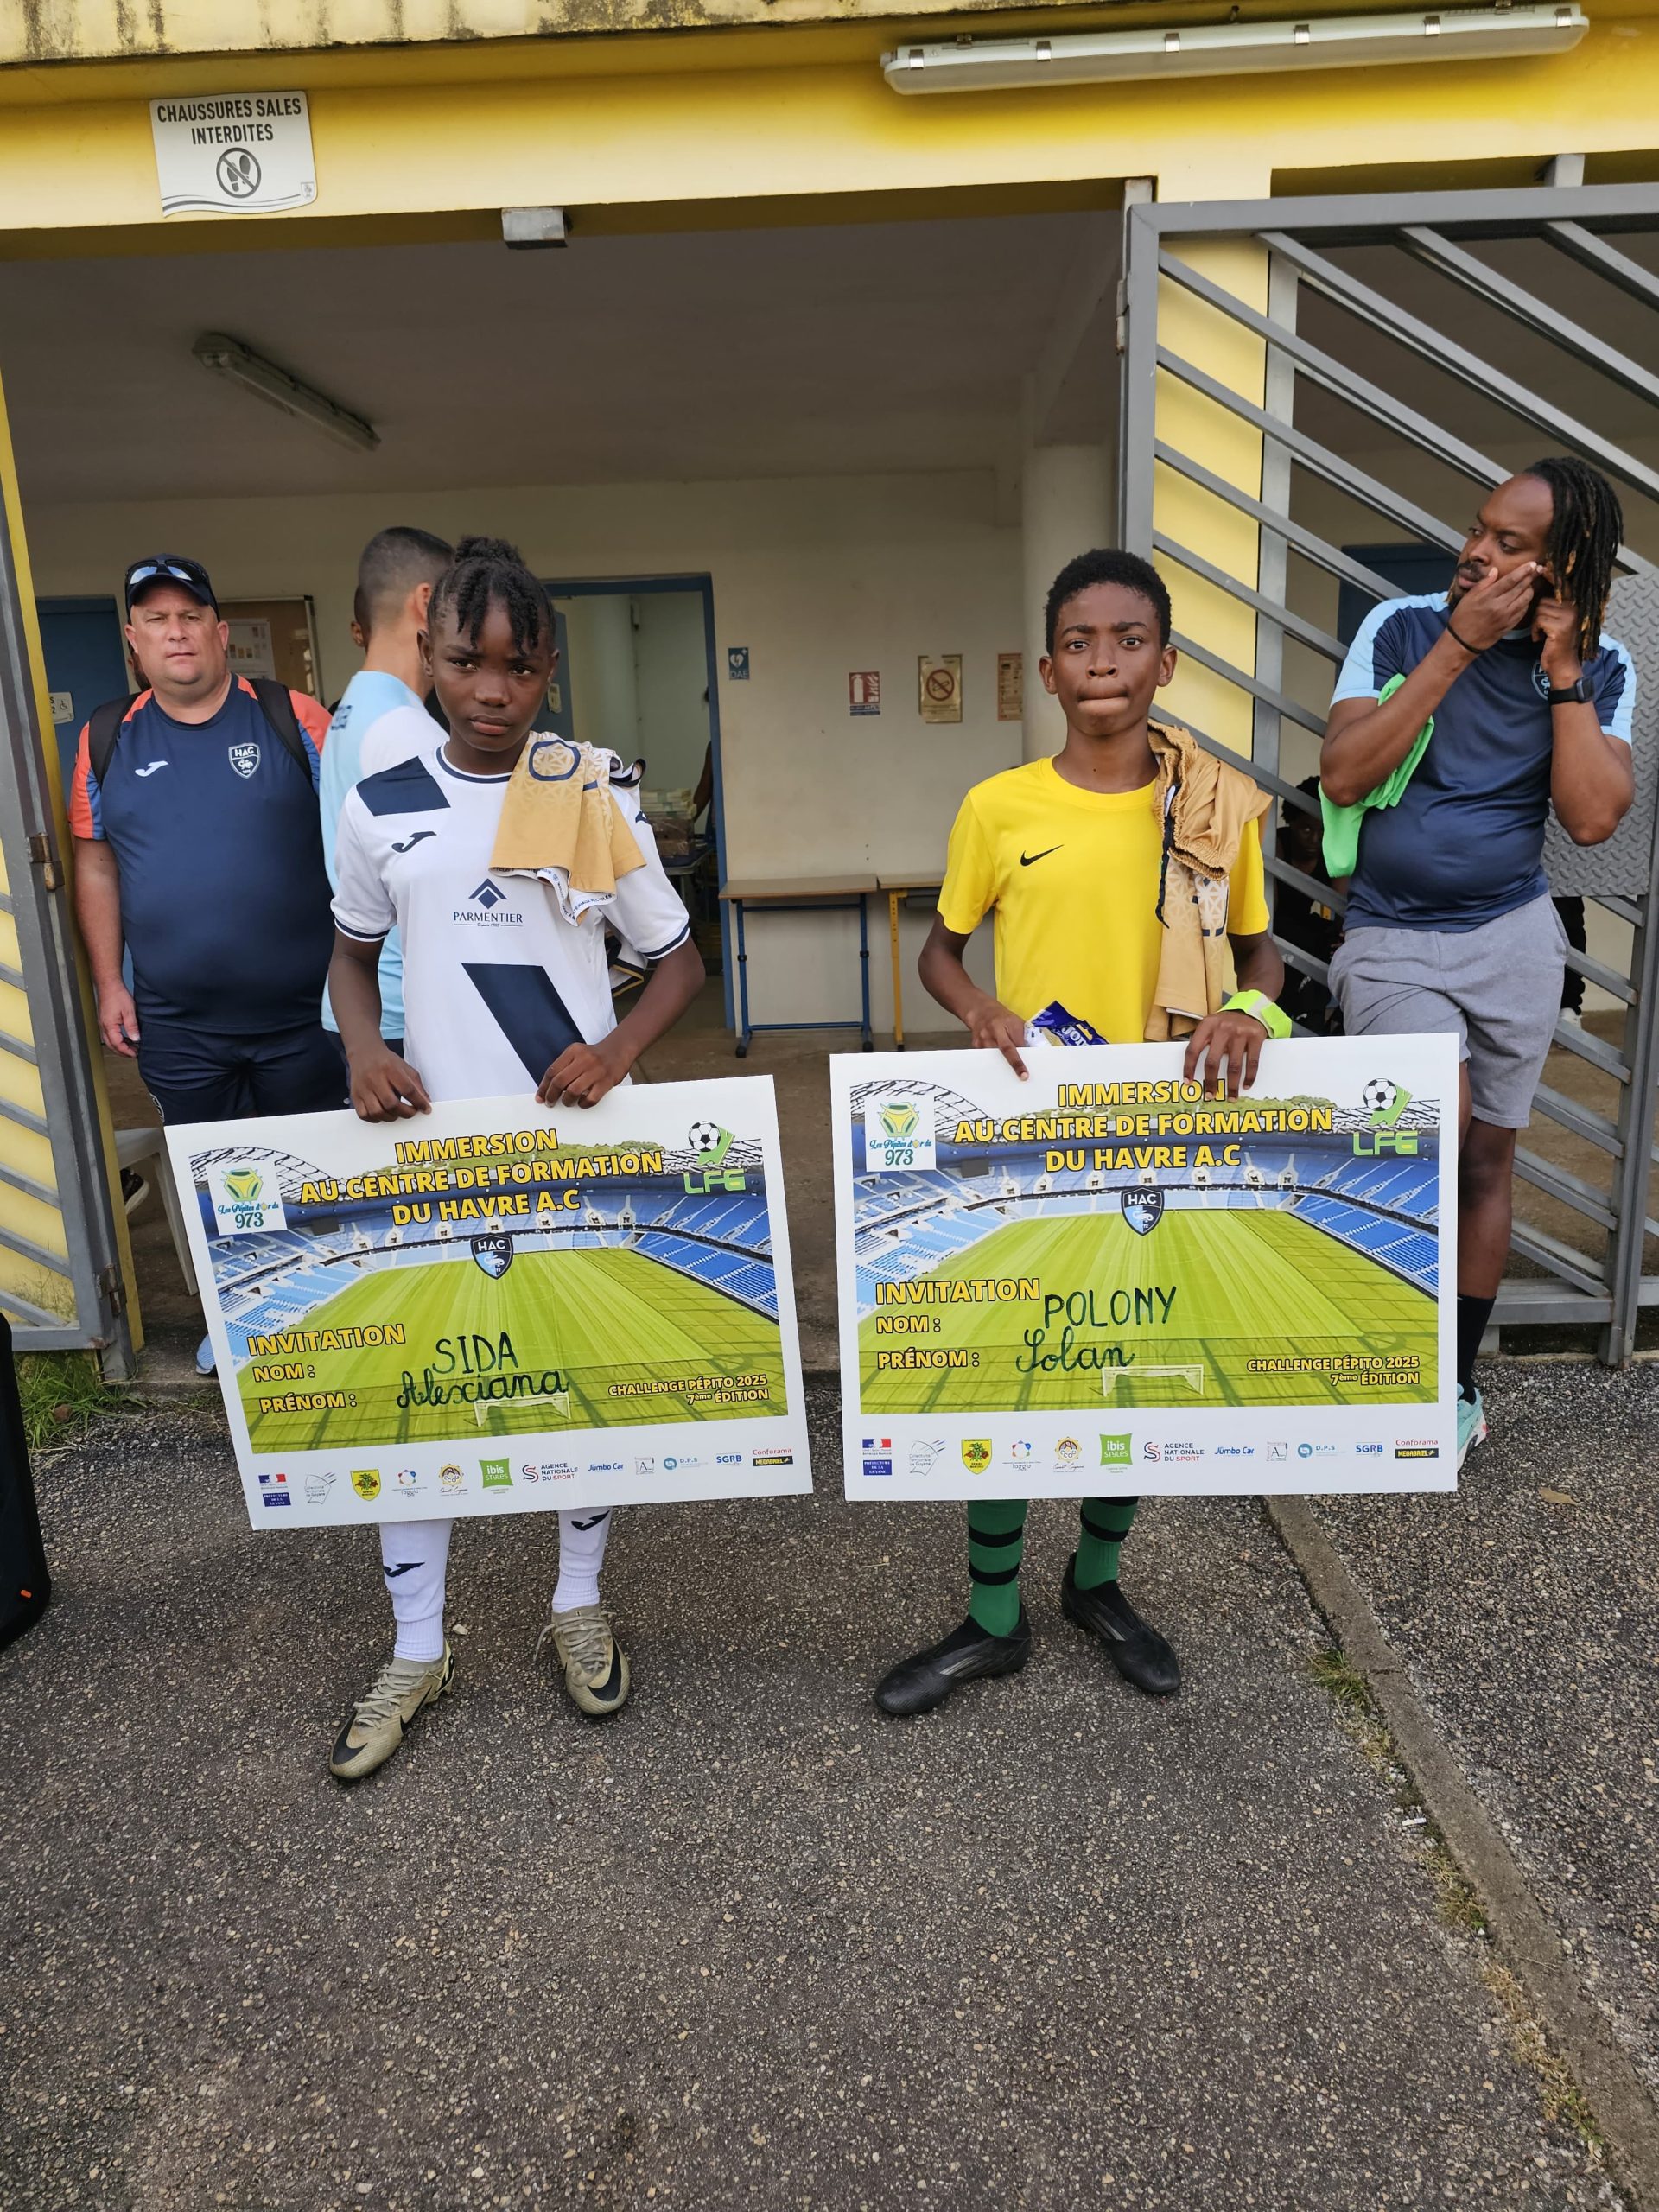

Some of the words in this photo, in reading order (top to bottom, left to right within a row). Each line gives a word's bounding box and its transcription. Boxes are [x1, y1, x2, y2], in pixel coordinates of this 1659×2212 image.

[156, 99, 253, 123] CHAUSSURES
[257, 98, 302, 118] SALES
[191, 124, 274, 145] INTERDITES
[729, 670, 749, 679] DAE
[234, 746, 255, 757] HAC
[454, 912, 523, 923] PARMENTIER
[953, 1120, 995, 1143] AU
[1001, 1116, 1109, 1141] CENTRE
[1115, 1114, 1151, 1137] DE
[1157, 1108, 1333, 1136] FORMATION
[394, 1128, 558, 1164] IMMERSION
[1352, 1129, 1419, 1156] LFG
[885, 1148, 914, 1166] 973
[1046, 1149, 1086, 1173] DU
[1093, 1145, 1188, 1170] HAVRE
[1193, 1143, 1242, 1167] A.C
[299, 1180, 340, 1205] AU
[345, 1169, 450, 1200] CENTRE
[454, 1166, 491, 1191] DE
[497, 1151, 663, 1186] FORMATION
[683, 1168, 747, 1195] LFG
[391, 1202, 433, 1226] DU
[438, 1195, 531, 1223] HAVRE
[537, 1189, 582, 1213] A.C
[1128, 1193, 1157, 1205] HAC
[235, 1212, 264, 1229] 973
[477, 1239, 506, 1252] HAC
[875, 1277, 1040, 1306] INVITATION
[1044, 1286, 1177, 1329] POLONY
[247, 1323, 406, 1357] INVITATION
[432, 1332, 518, 1375] SIDA
[1247, 1357, 1331, 1372] CHALLENGE
[1333, 1355, 1383, 1370] PÉPITO
[1385, 1356, 1420, 1369] 2025
[608, 1380, 686, 1397] CHALLENGE
[688, 1376, 734, 1391] PÉPITO
[736, 1374, 768, 1388] 2025
[1331, 1373, 1358, 1386] 7ème
[1360, 1370, 1420, 1386] ÉDITION
[685, 1392, 712, 1405] 7ème
[714, 1389, 770, 1404] ÉDITION
[752, 1447, 792, 1456] Conforama
[1107, 1440, 1125, 1451] ibis
[1242, 1446, 1255, 1455] Car
[1356, 1444, 1383, 1453] SGRB
[613, 1462, 624, 1471] Car
[715, 1454, 743, 1464] SGRB
[486, 1465, 505, 1474] ibis
